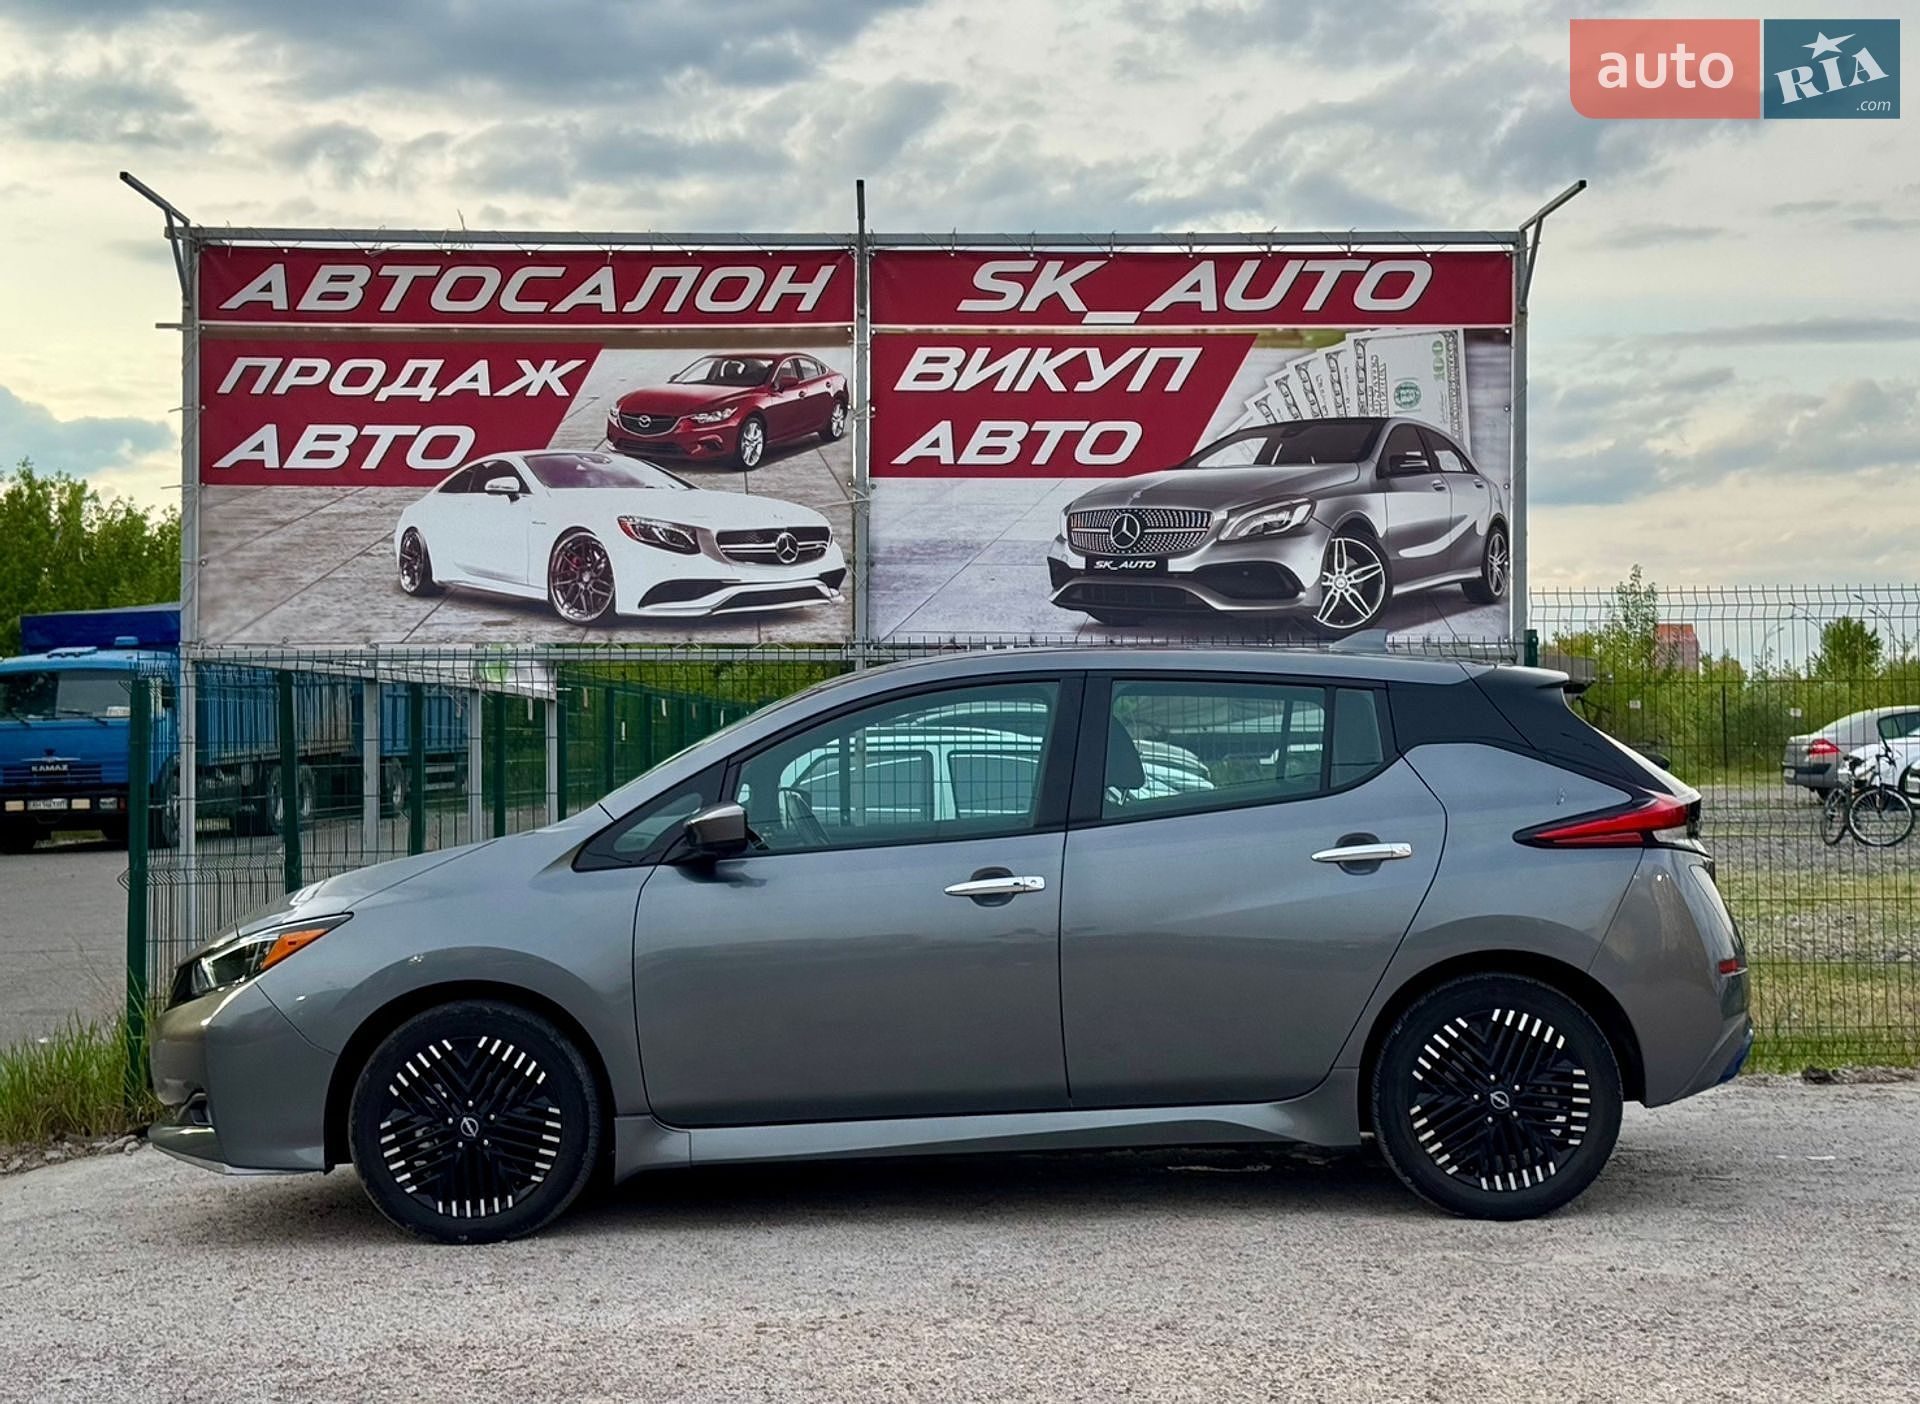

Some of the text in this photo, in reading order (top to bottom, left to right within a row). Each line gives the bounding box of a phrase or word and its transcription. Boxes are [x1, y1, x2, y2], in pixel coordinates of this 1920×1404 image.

[218, 263, 836, 312] АВТОСАЛОН
[957, 259, 1432, 324] SK_AUTO
[216, 357, 586, 402] ПРОДАЖ
[893, 346, 1202, 392] ВИКУП
[212, 423, 476, 470] АВТО
[891, 419, 1142, 465] АВТО
[1095, 560, 1156, 570] SK_AUTO
